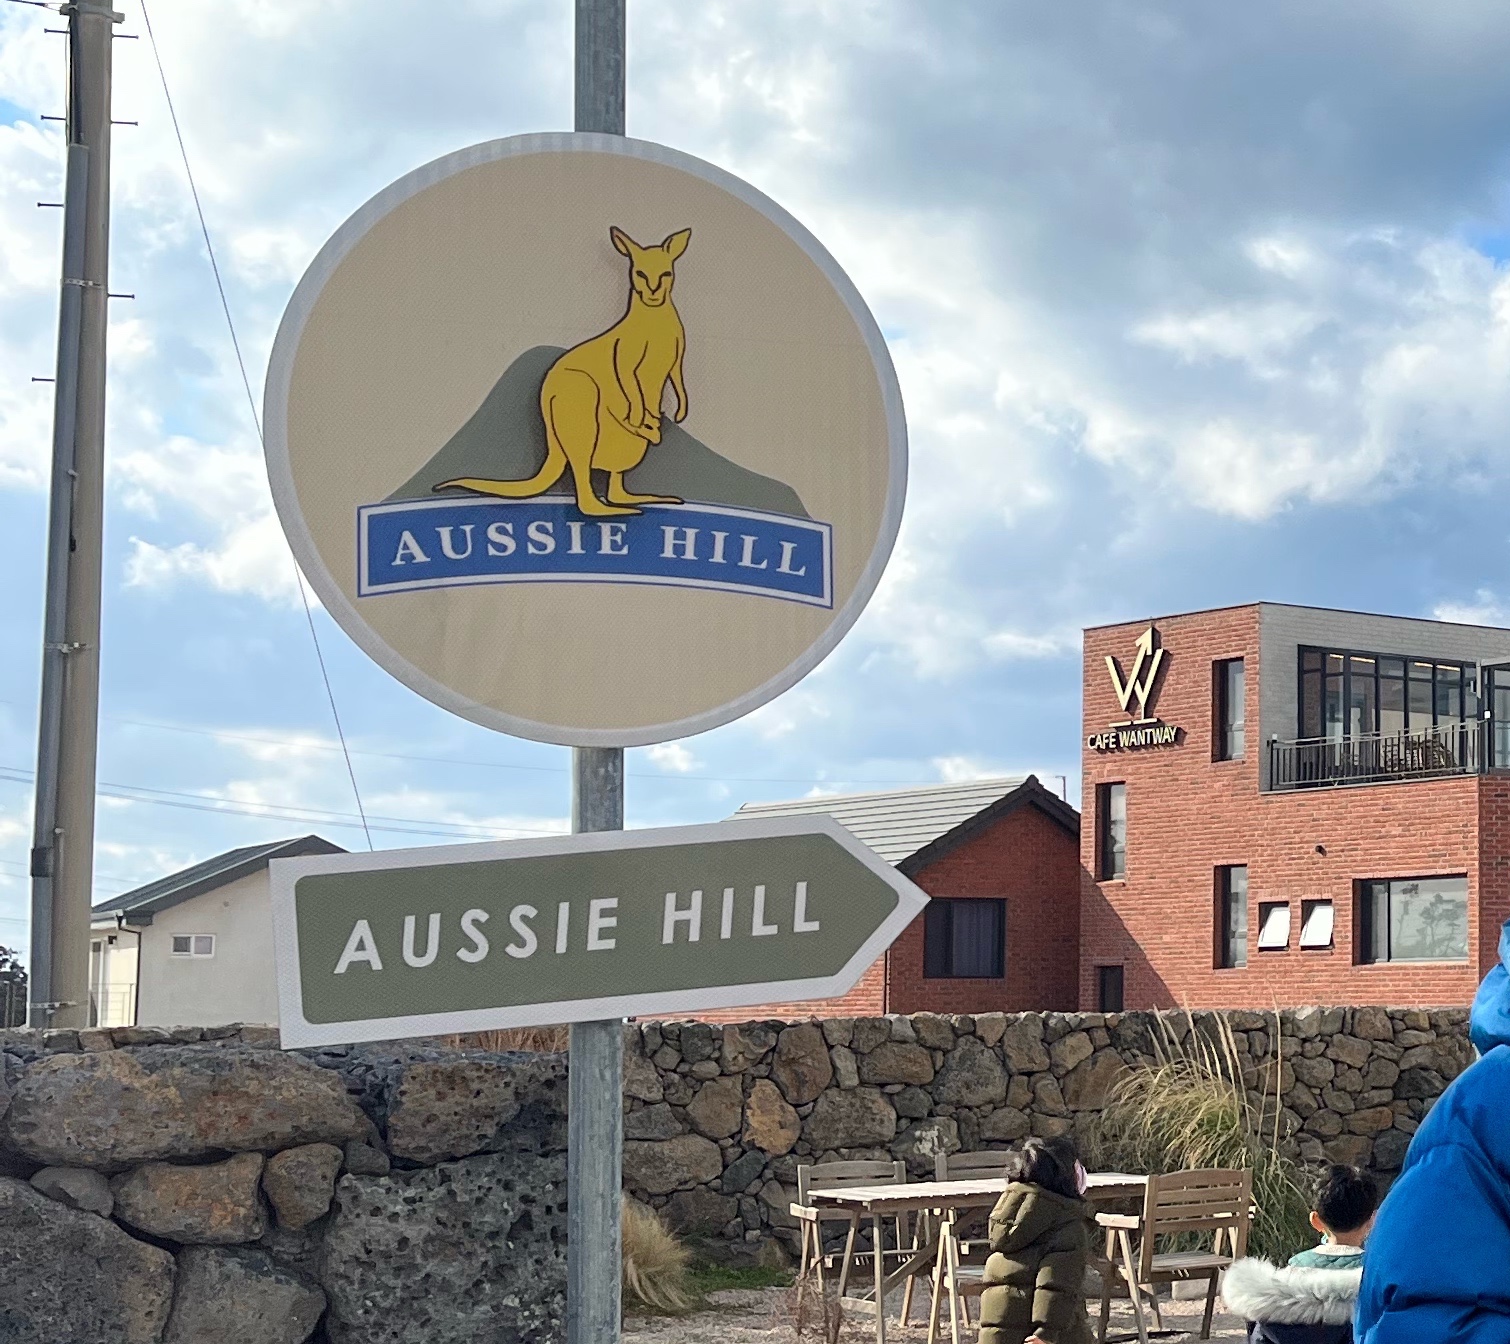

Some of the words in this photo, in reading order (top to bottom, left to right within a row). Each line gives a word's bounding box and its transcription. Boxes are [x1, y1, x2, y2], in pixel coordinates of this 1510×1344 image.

[391, 521, 630, 566] AUSSIE
[660, 525, 807, 577] HILL
[1087, 732, 1117, 750] CAFE
[1118, 725, 1178, 748] WANTWAY
[334, 897, 619, 975] AUSSIE
[661, 881, 821, 945] HILL
